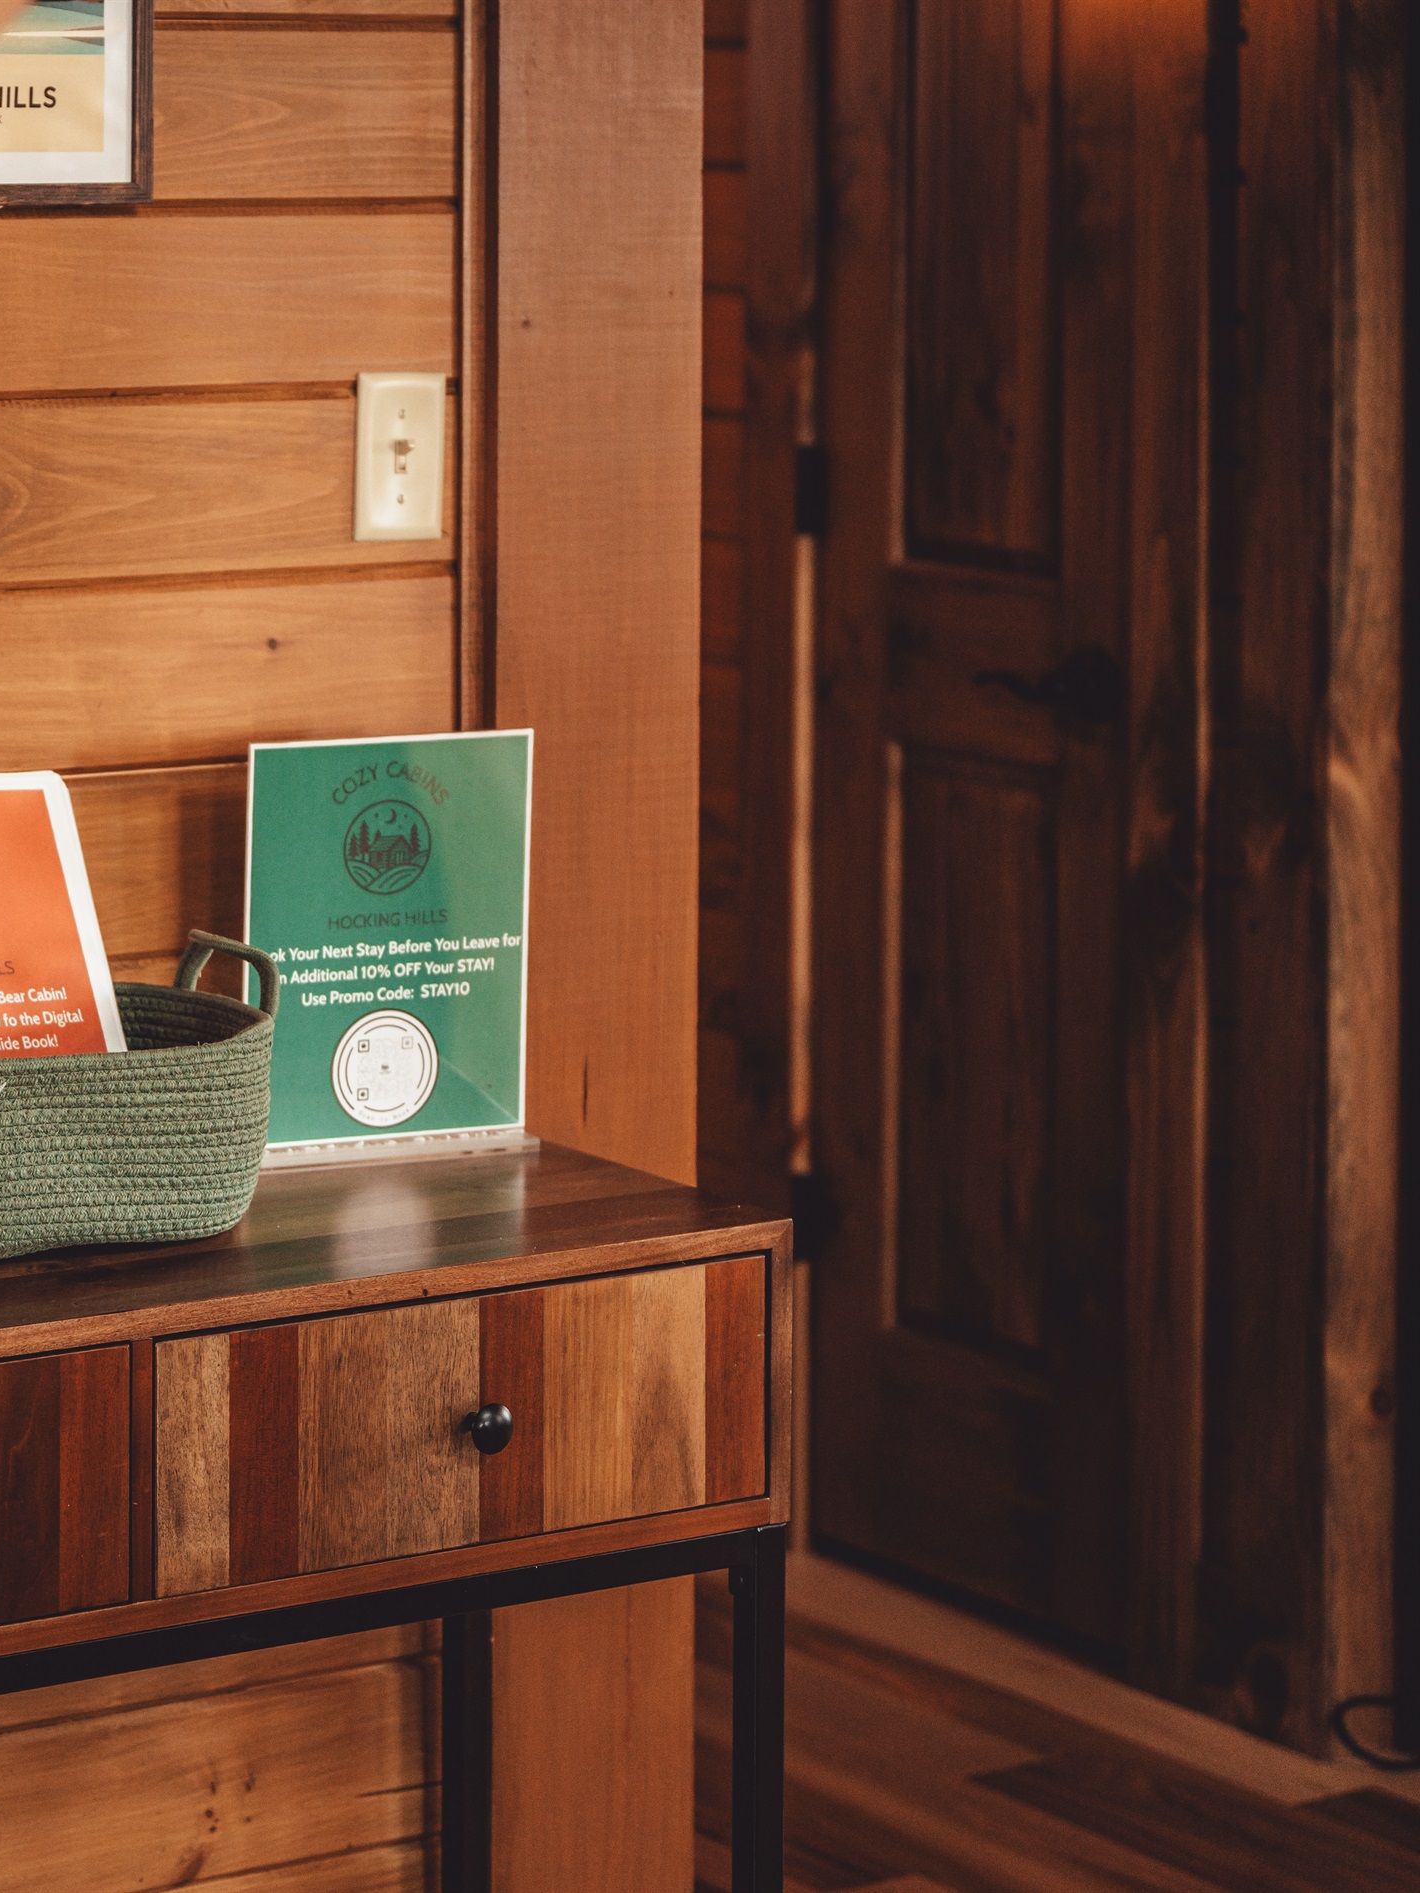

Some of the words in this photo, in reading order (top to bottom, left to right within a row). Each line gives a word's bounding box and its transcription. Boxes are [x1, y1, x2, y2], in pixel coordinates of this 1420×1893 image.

[331, 762, 378, 806] COZY
[386, 760, 450, 806] CABINS
[328, 911, 401, 931] HOCKING
[404, 909, 449, 926] HILLS
[270, 947, 287, 963] ok
[289, 946, 319, 962] Your
[322, 944, 353, 959] Next
[356, 942, 386, 959] Stay
[388, 939, 432, 955] Before
[434, 938, 460, 951] You
[462, 935, 500, 949] Leave
[502, 932, 522, 946] for
[280, 971, 291, 985] n
[291, 964, 358, 984] Additional
[361, 963, 391, 979] 10%
[393, 961, 422, 976] OFF
[424, 960, 455, 976] Your
[456, 957, 495, 973] STAY!
[27, 986, 68, 1002] Cabin!
[301, 992, 327, 1007] Use
[330, 989, 374, 1005] Promo
[376, 986, 415, 1002] Code:
[419, 981, 471, 999] STAY10
[2, 1012, 18, 1027] fo
[19, 1010, 41, 1026] the
[42, 1007, 84, 1028] Digital
[22, 1033, 59, 1050] Book!
